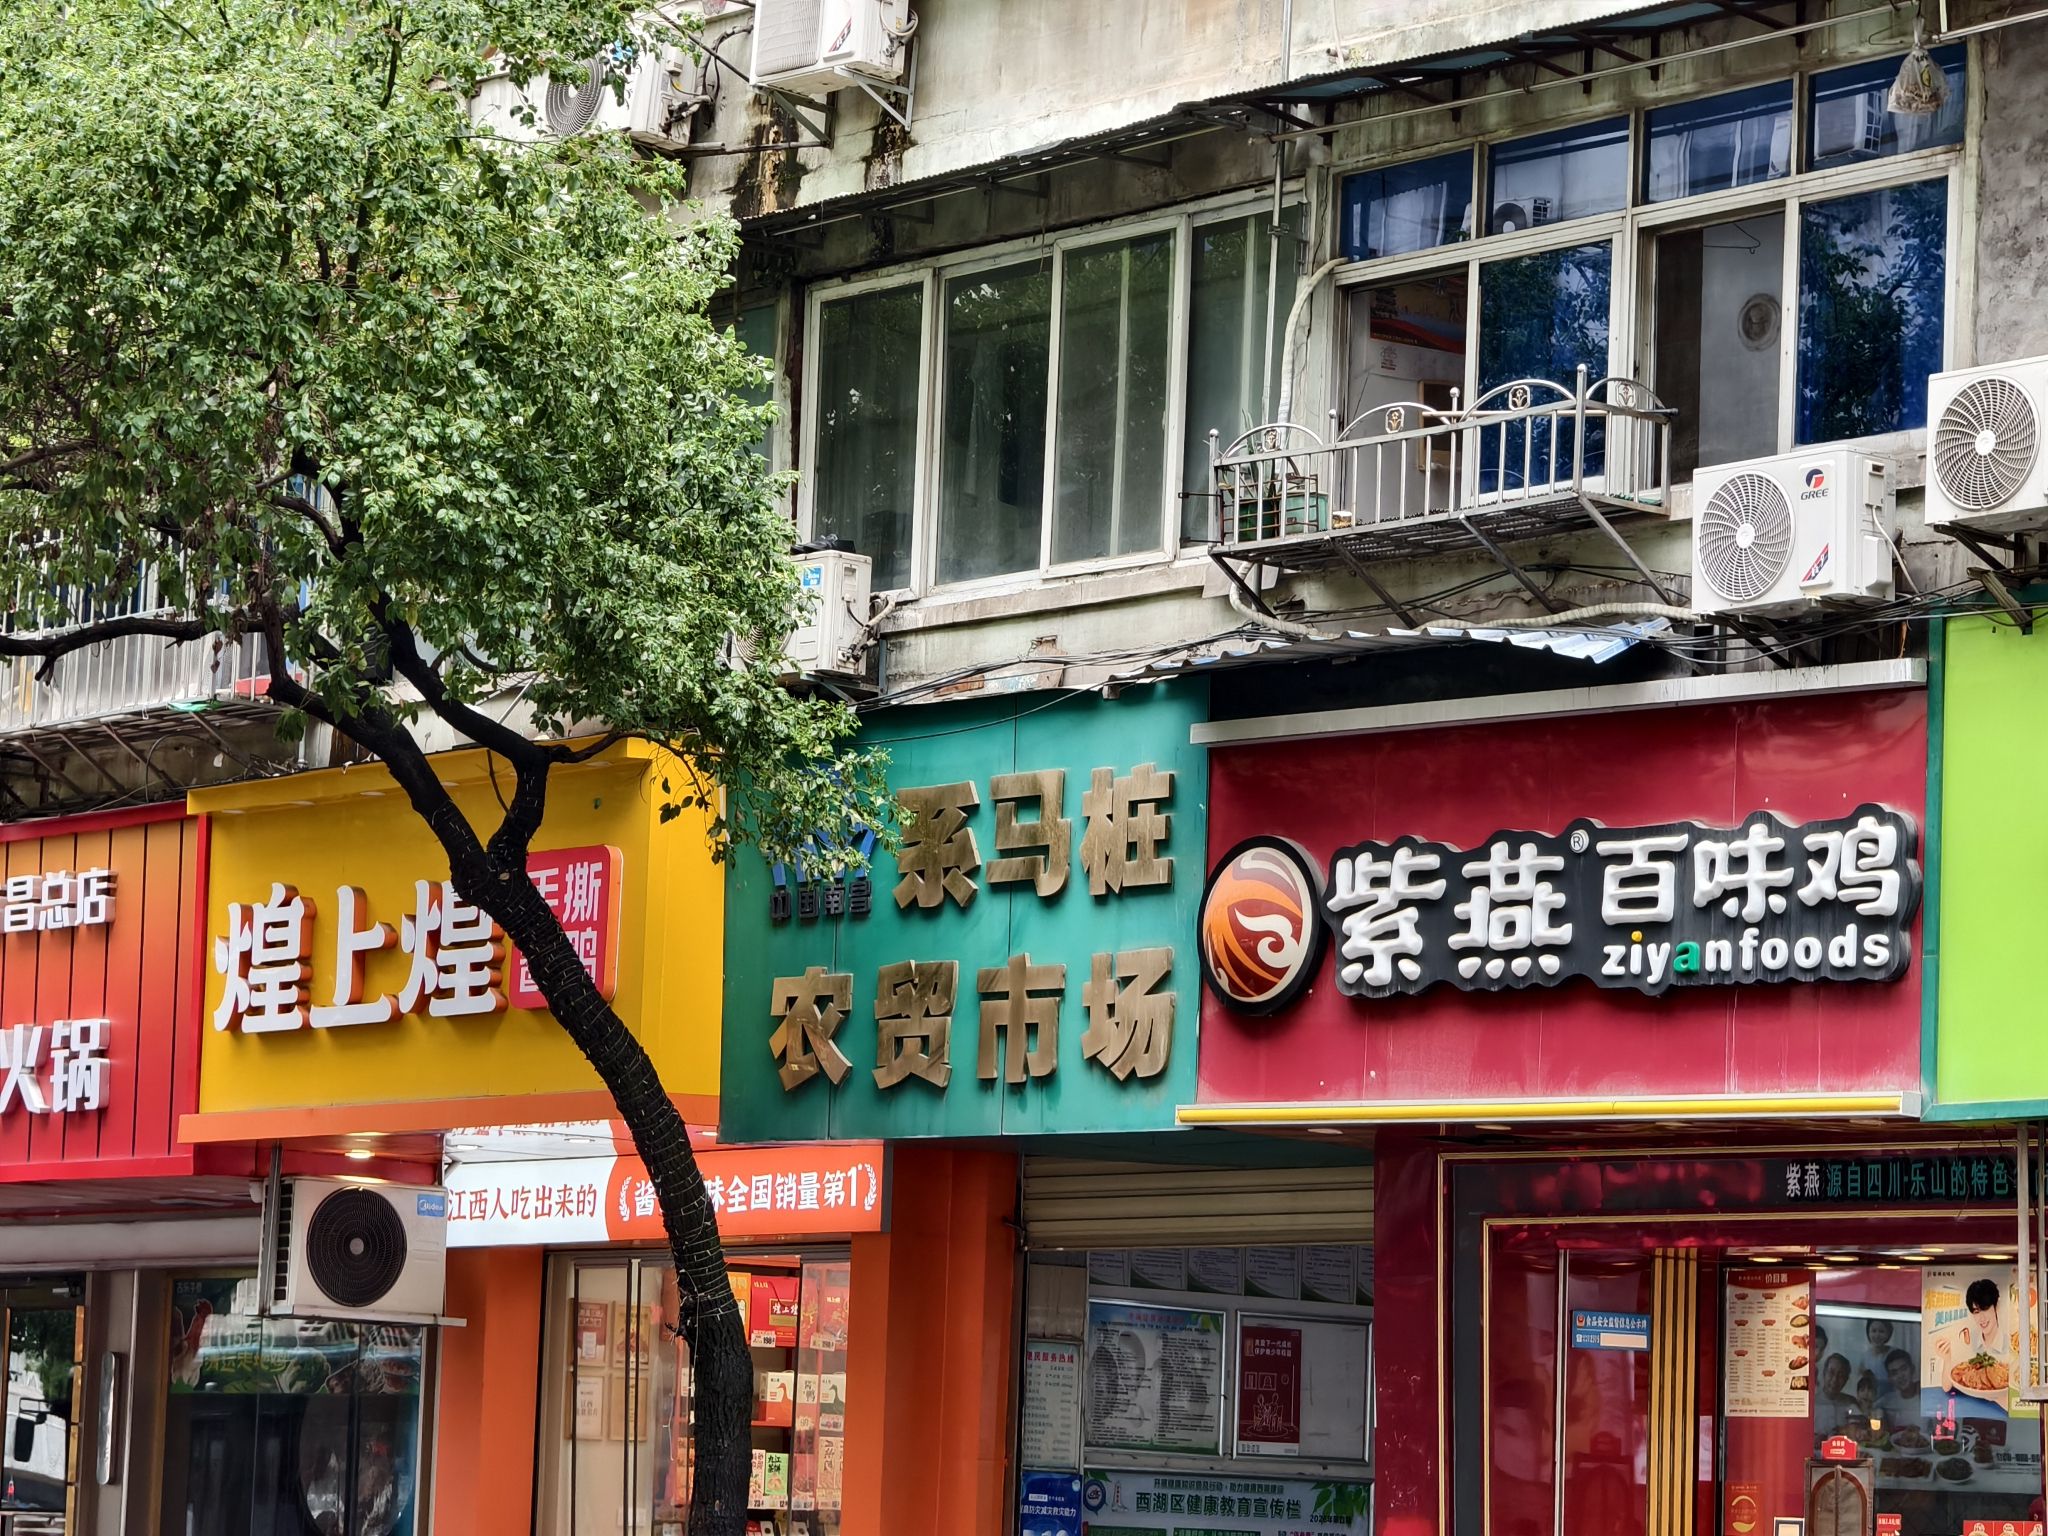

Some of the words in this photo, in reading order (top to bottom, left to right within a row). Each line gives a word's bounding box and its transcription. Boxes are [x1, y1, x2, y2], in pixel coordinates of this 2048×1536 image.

[1800, 488, 1829, 500] GREE
[892, 763, 1176, 909] 系马桩
[770, 880, 872, 920] 中国南昌
[212, 879, 506, 1034] 煌上煌
[1602, 923, 1890, 984] ziyanfoods
[768, 947, 1177, 1092] 农贸市场
[0, 1018, 111, 1114] 火锅
[447, 1183, 597, 1222] 江西人吃出来的
[1135, 1491, 1301, 1520] 西湖区健康教育宣传栏
